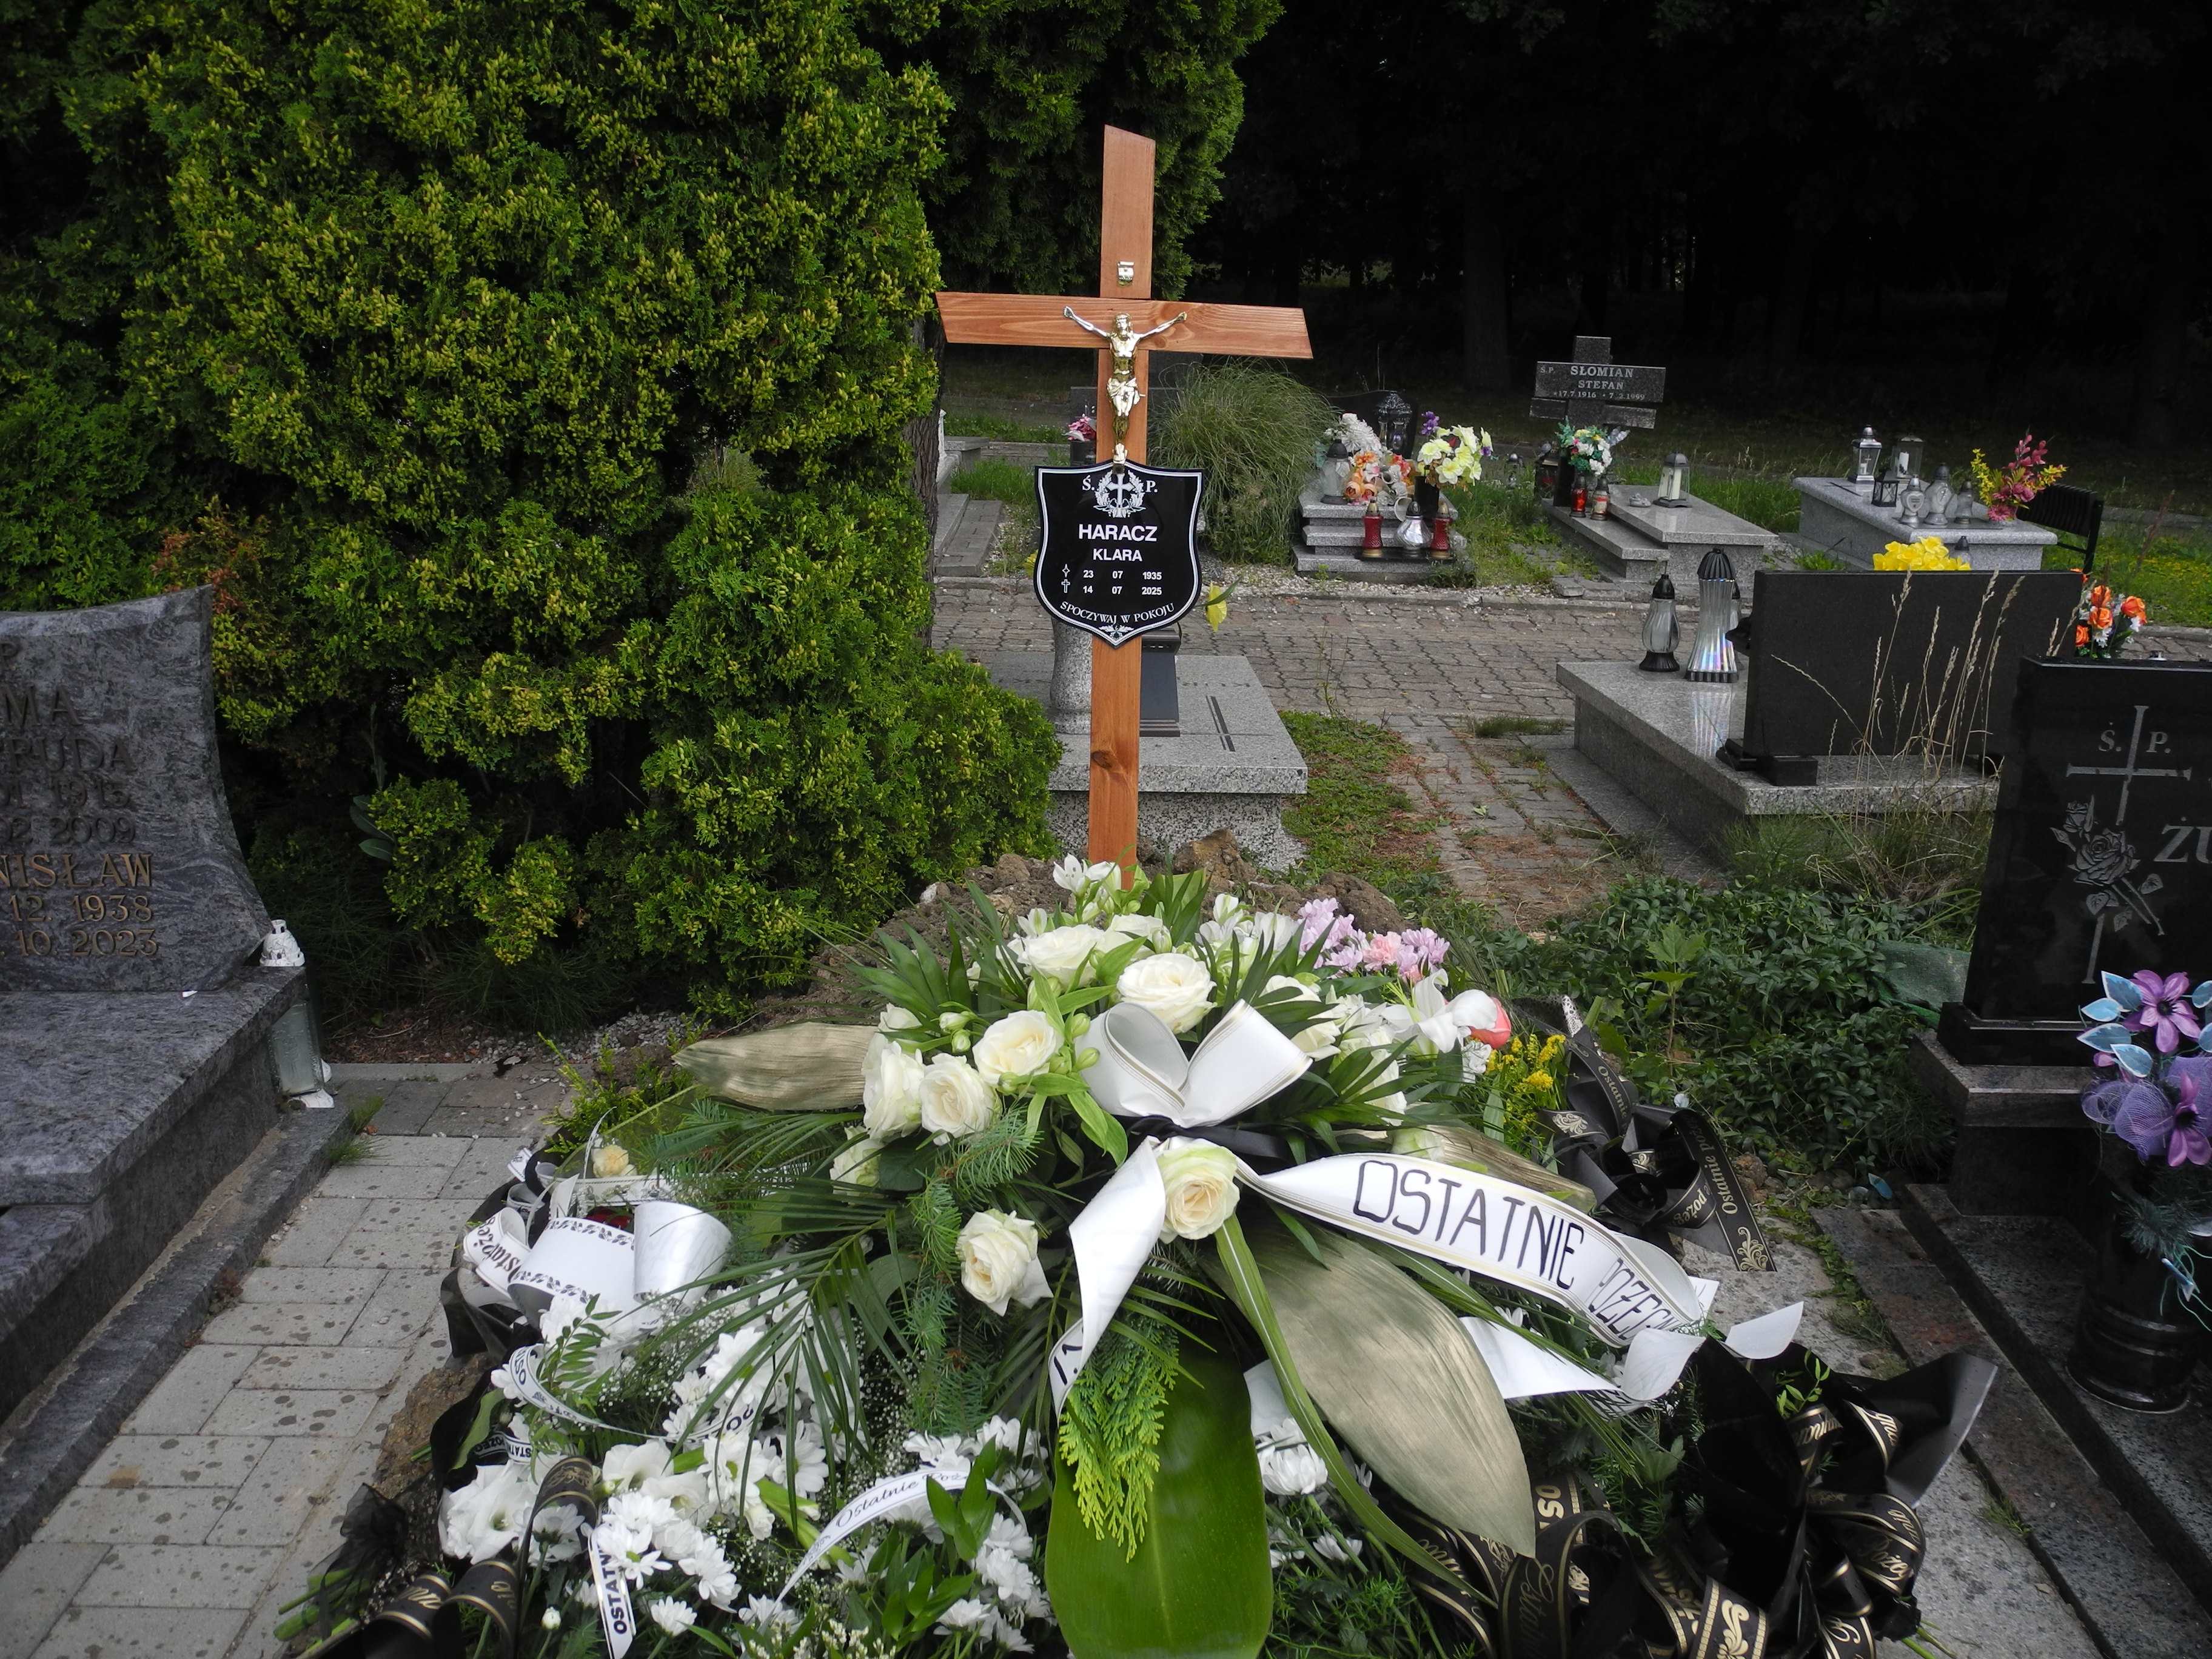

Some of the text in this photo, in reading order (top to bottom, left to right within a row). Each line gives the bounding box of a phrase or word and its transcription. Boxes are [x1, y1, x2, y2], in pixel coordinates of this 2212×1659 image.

[1570, 365, 1634, 378] SŁOMIAN
[1578, 380, 1624, 390] STEFAN
[1081, 474, 1158, 493] Ś. P.
[1078, 523, 1158, 542] HARACZ
[1093, 548, 1143, 561] KLARA
[1083, 569, 1162, 580] 23 07 1935
[1082, 585, 1162, 595] 14 07 2025
[1060, 601, 1175, 625] SPOCZYWAJ W POKOJU
[2146, 731, 2173, 754] P.
[72, 894, 152, 922] 1938
[70, 928, 158, 956] 2023
[1597, 1065, 1628, 1119] Ostatnie
[1704, 1155, 1738, 1215] Ostatnie
[1353, 1159, 1584, 1290] OSTATNIE
[835, 1480, 920, 1529] Ostatnie
[598, 1548, 628, 1635] OSTATN
